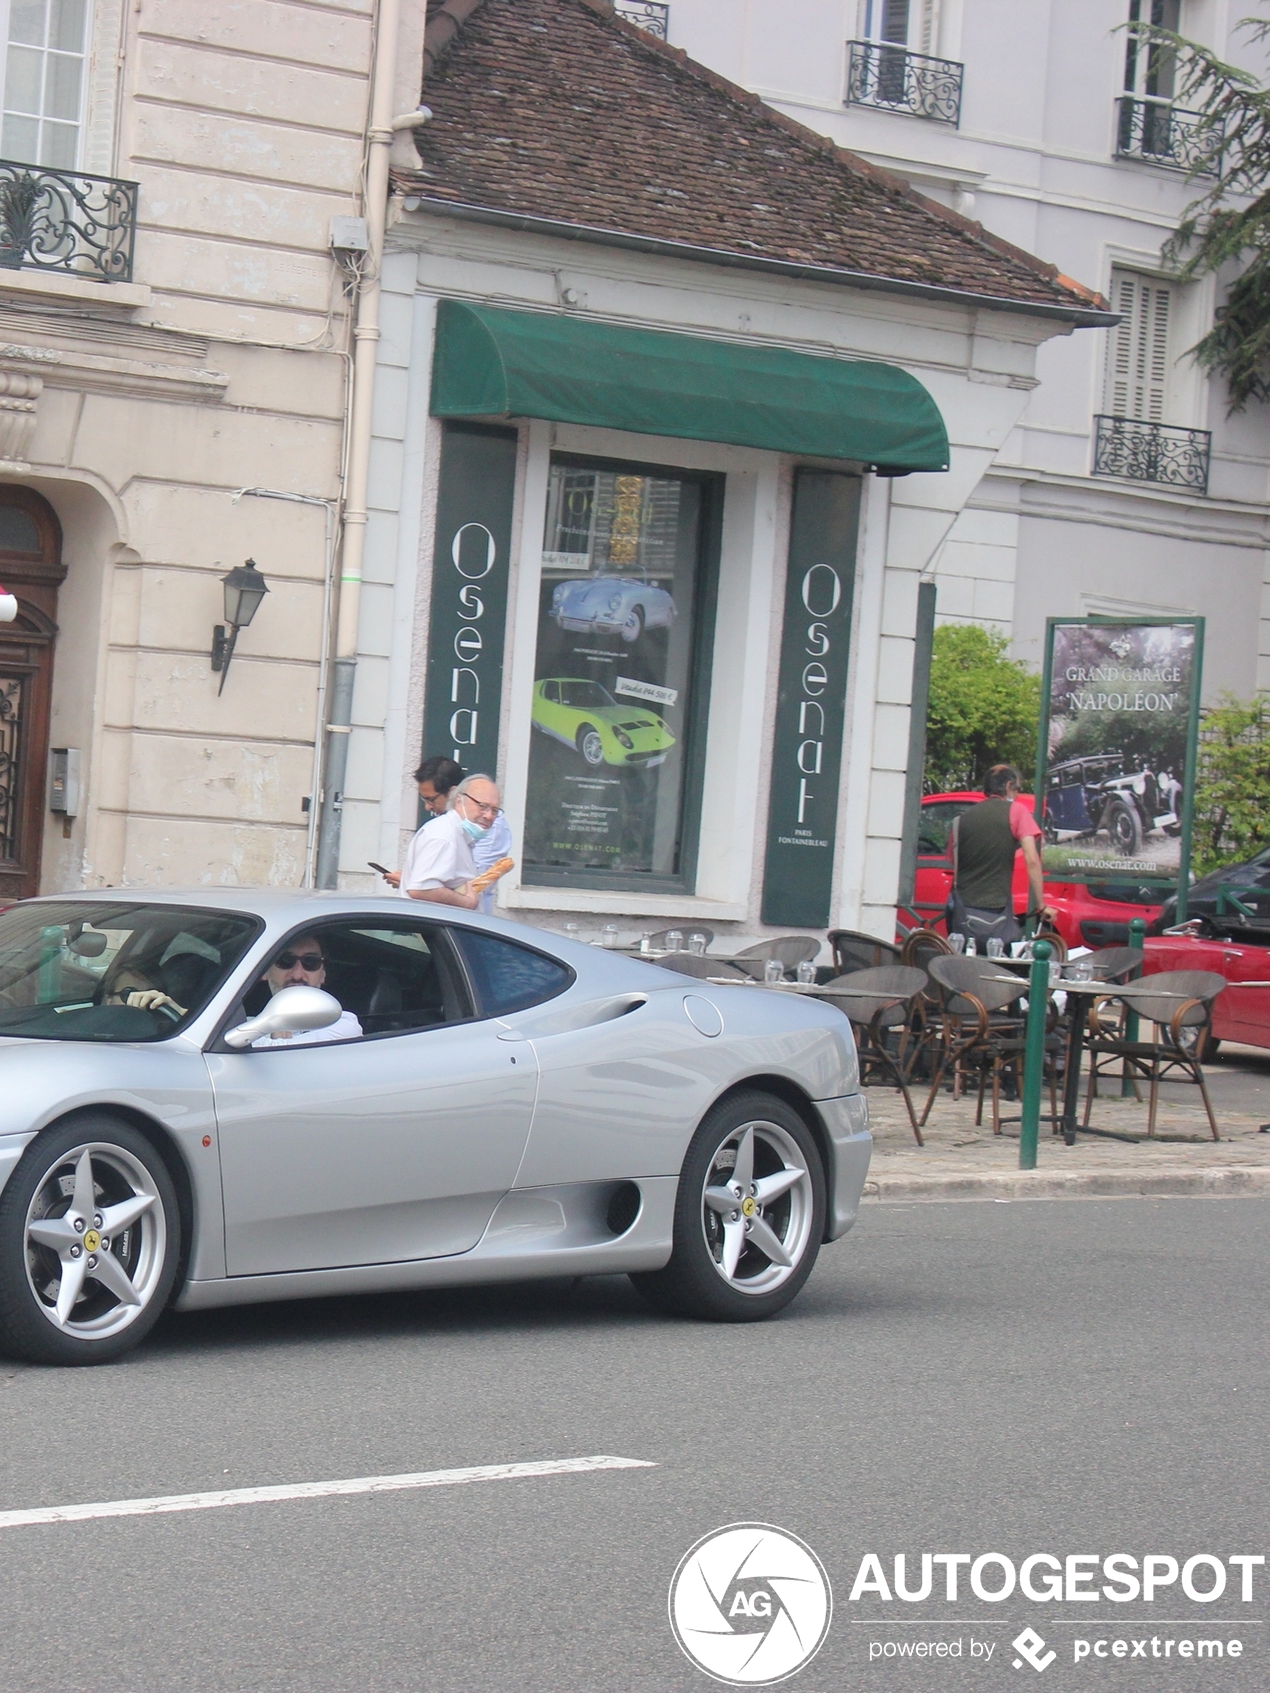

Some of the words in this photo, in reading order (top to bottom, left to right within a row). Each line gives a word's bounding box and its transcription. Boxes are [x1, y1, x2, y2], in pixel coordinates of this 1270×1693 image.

[1065, 667, 1119, 681] GRAND
[1121, 667, 1182, 682] GARAGE
[797, 563, 841, 823] Osenat
[794, 829, 812, 837] PARIS
[1067, 858, 1157, 872] www.osenat.com
